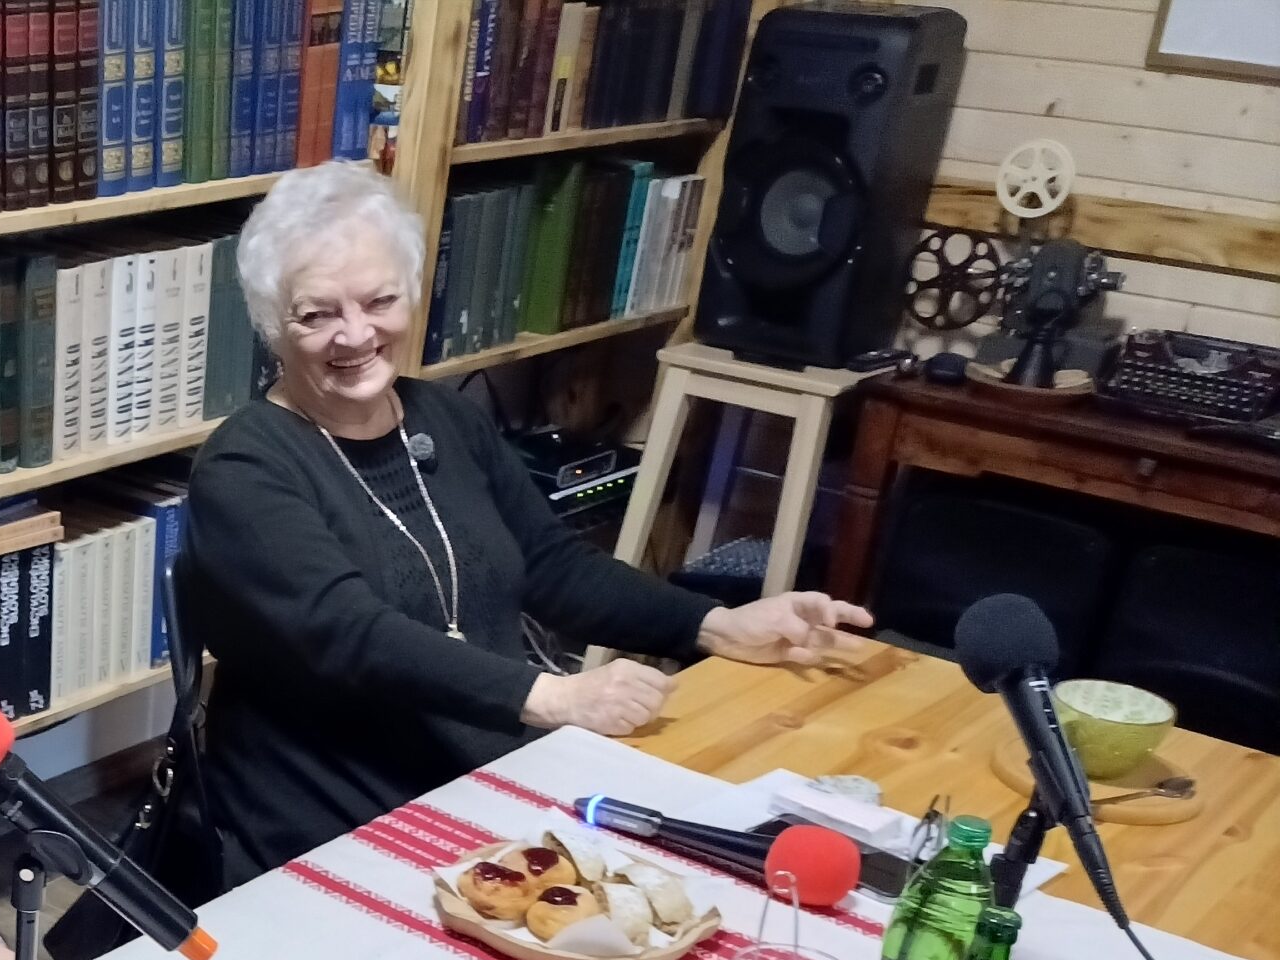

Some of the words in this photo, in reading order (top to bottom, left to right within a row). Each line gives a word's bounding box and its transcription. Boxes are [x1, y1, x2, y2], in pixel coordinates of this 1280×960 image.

[63, 343, 81, 451] SLOVENSKO
[90, 336, 108, 442] SLOVENSKO
[116, 326, 135, 438] SLOVENSKO
[135, 324, 155, 434] SLOVENSKO
[159, 322, 179, 426] SLOVENSKO
[186, 315, 205, 419] SLOVENSKO
[56, 570, 66, 636] SLOVENSKA
[78, 563, 88, 627] SLOVENSKA
[101, 554, 111, 617] SLOVENSKA
[120, 548, 131, 611] SLOVENSKA
